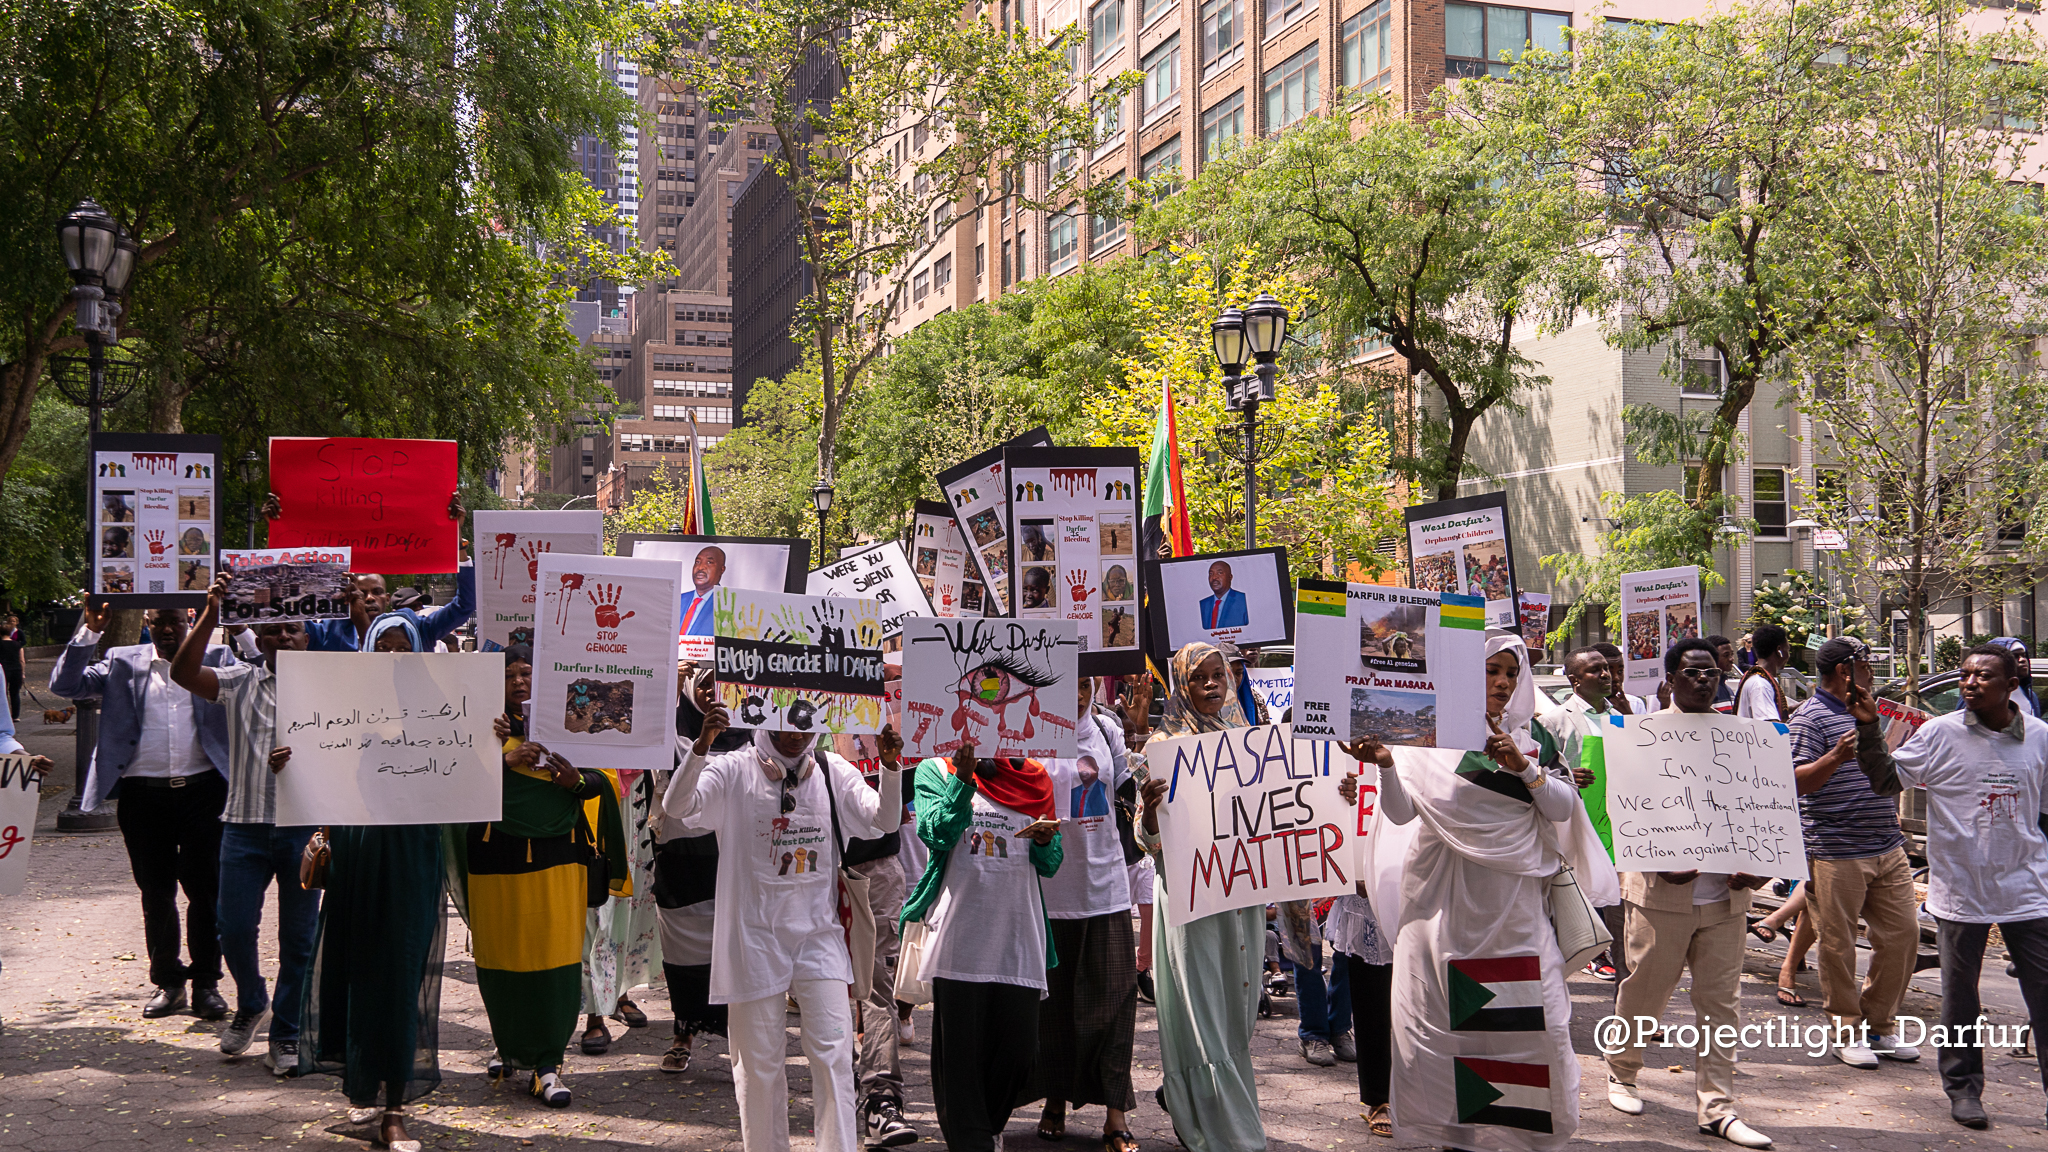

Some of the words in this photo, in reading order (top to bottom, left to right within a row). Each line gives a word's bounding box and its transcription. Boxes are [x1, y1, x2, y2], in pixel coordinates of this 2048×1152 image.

[317, 443, 409, 482] STOP
[1421, 522, 1446, 532] West
[1448, 515, 1492, 528] Darfur's
[365, 532, 380, 549] in
[384, 533, 433, 551] Dafur
[1462, 530, 1494, 538] Children
[226, 553, 274, 567] Take
[278, 551, 344, 564] Action
[823, 560, 858, 580] WERE
[862, 551, 884, 567] YOU
[1655, 581, 1688, 590] Darfur's
[875, 588, 896, 604] OR
[1347, 591, 1385, 602] DARFUR
[1400, 596, 1442, 607] BLEEDING
[222, 600, 263, 619] For
[269, 594, 346, 617] Sudan
[1521, 602, 1547, 612] Needs
[495, 613, 530, 622] Darfur
[1066, 612, 1093, 620] GENOCIDE
[596, 631, 618, 640] STOP
[934, 619, 1003, 655] West
[586, 643, 628, 654] GENOCIDE
[554, 662, 593, 673] Darfur
[594, 664, 604, 674] Is
[606, 665, 654, 678] Bleeding
[1346, 676, 1370, 686] PRAY
[1374, 679, 1392, 688] DAR
[1394, 680, 1434, 690] MASARA
[1304, 701, 1330, 711] FREE
[1877, 704, 1904, 720] Save
[1306, 714, 1327, 723] DAR
[1293, 725, 1336, 735] ANDOKA
[1637, 718, 1701, 746] Save
[1711, 725, 1773, 759] people
[1659, 757, 1697, 779] In
[1662, 786, 1695, 812] call
[1702, 790, 1730, 812] the
[1735, 797, 1797, 813] International
[985, 812, 1008, 821] Killing
[1211, 780, 1314, 840] LIVES
[986, 820, 1015, 831] Darfur
[1721, 812, 1745, 835] to
[1750, 817, 1788, 836] take
[798, 836, 826, 845] Darfur
[1622, 840, 1676, 859] action
[1683, 837, 1739, 862] against
[1190, 823, 1348, 912] MATTER
